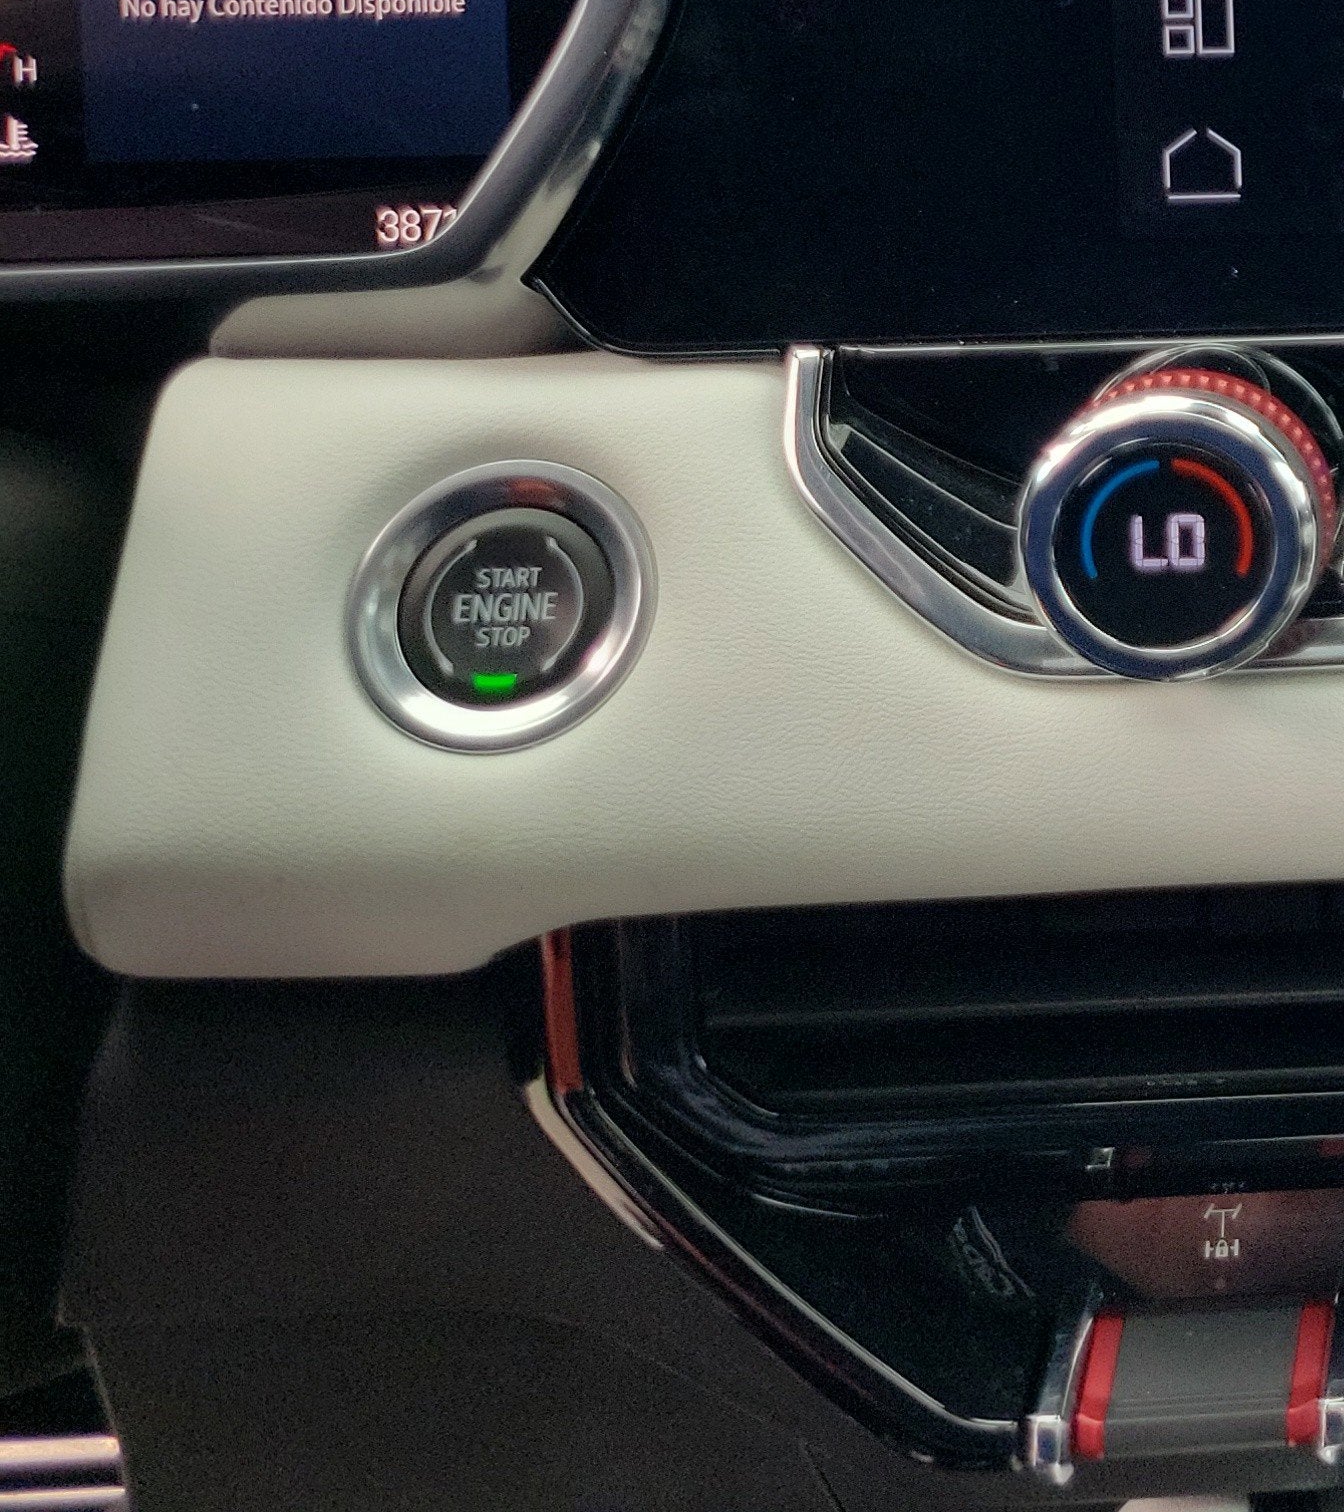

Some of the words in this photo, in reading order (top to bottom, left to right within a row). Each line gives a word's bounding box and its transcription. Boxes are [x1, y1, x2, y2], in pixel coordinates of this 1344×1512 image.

[13, 56, 38, 86] H
[1129, 512, 1206, 572] LO
[475, 565, 543, 590] START
[454, 591, 559, 624] ENGINE
[474, 625, 532, 648] STOP
